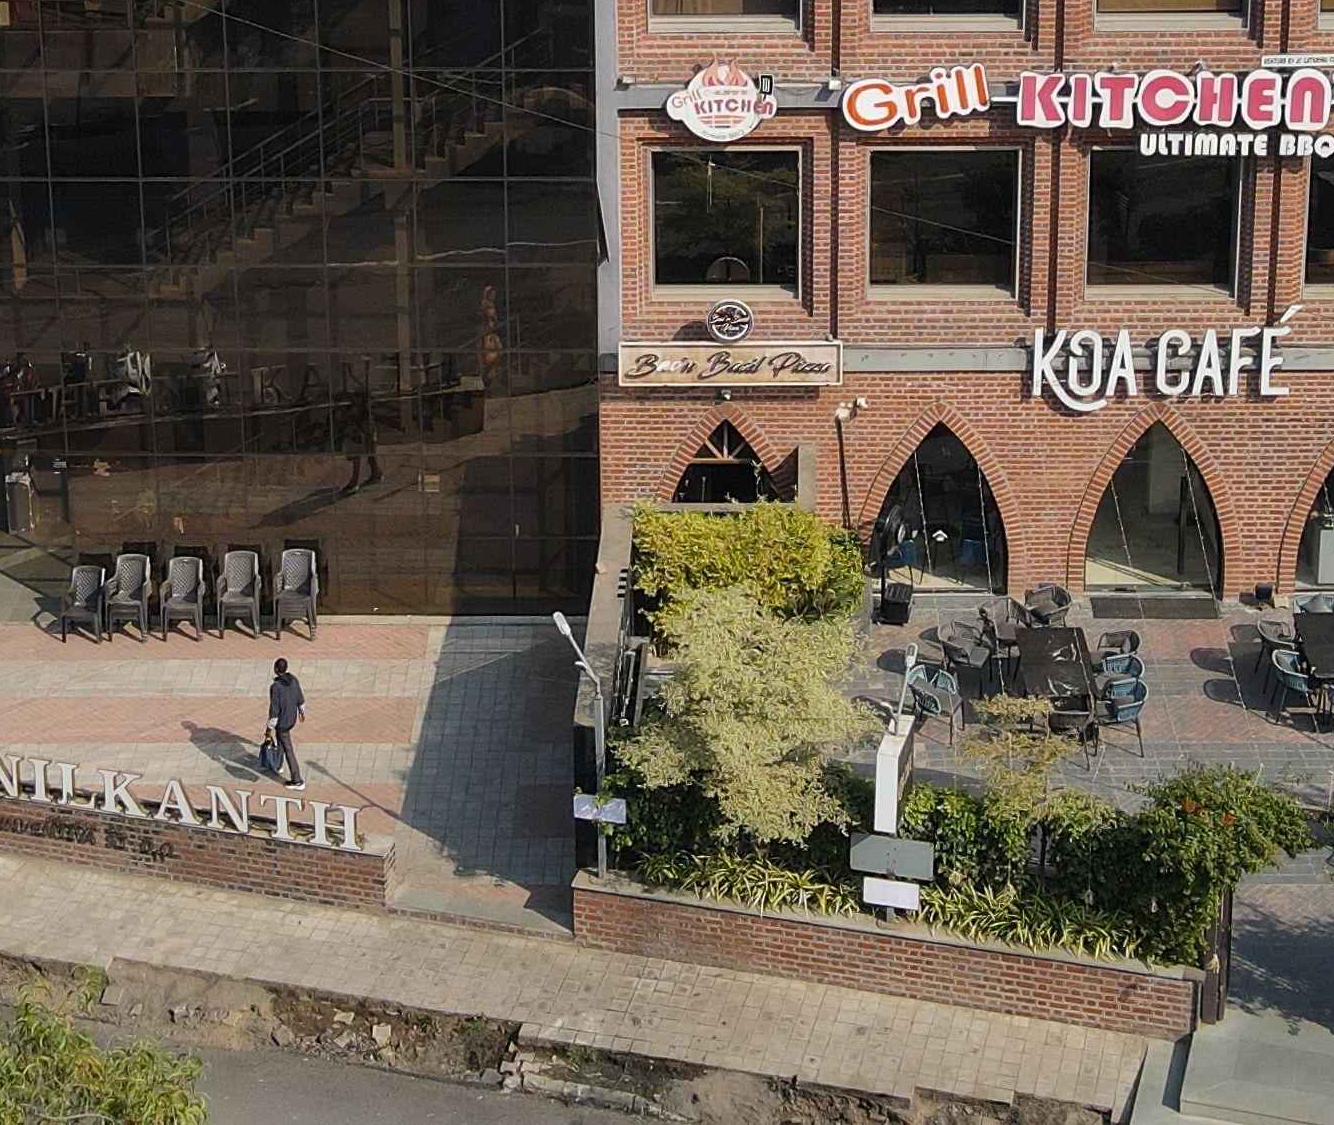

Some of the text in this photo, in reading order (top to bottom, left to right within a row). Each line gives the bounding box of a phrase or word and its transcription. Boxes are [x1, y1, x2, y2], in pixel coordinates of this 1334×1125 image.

[671, 89, 702, 109] Grill
[845, 64, 1328, 128] Grill KITCHEN
[1139, 133, 1269, 157] ULTIMATE
[767, 352, 832, 378] Pizza
[1032, 327, 1138, 411] KOA
